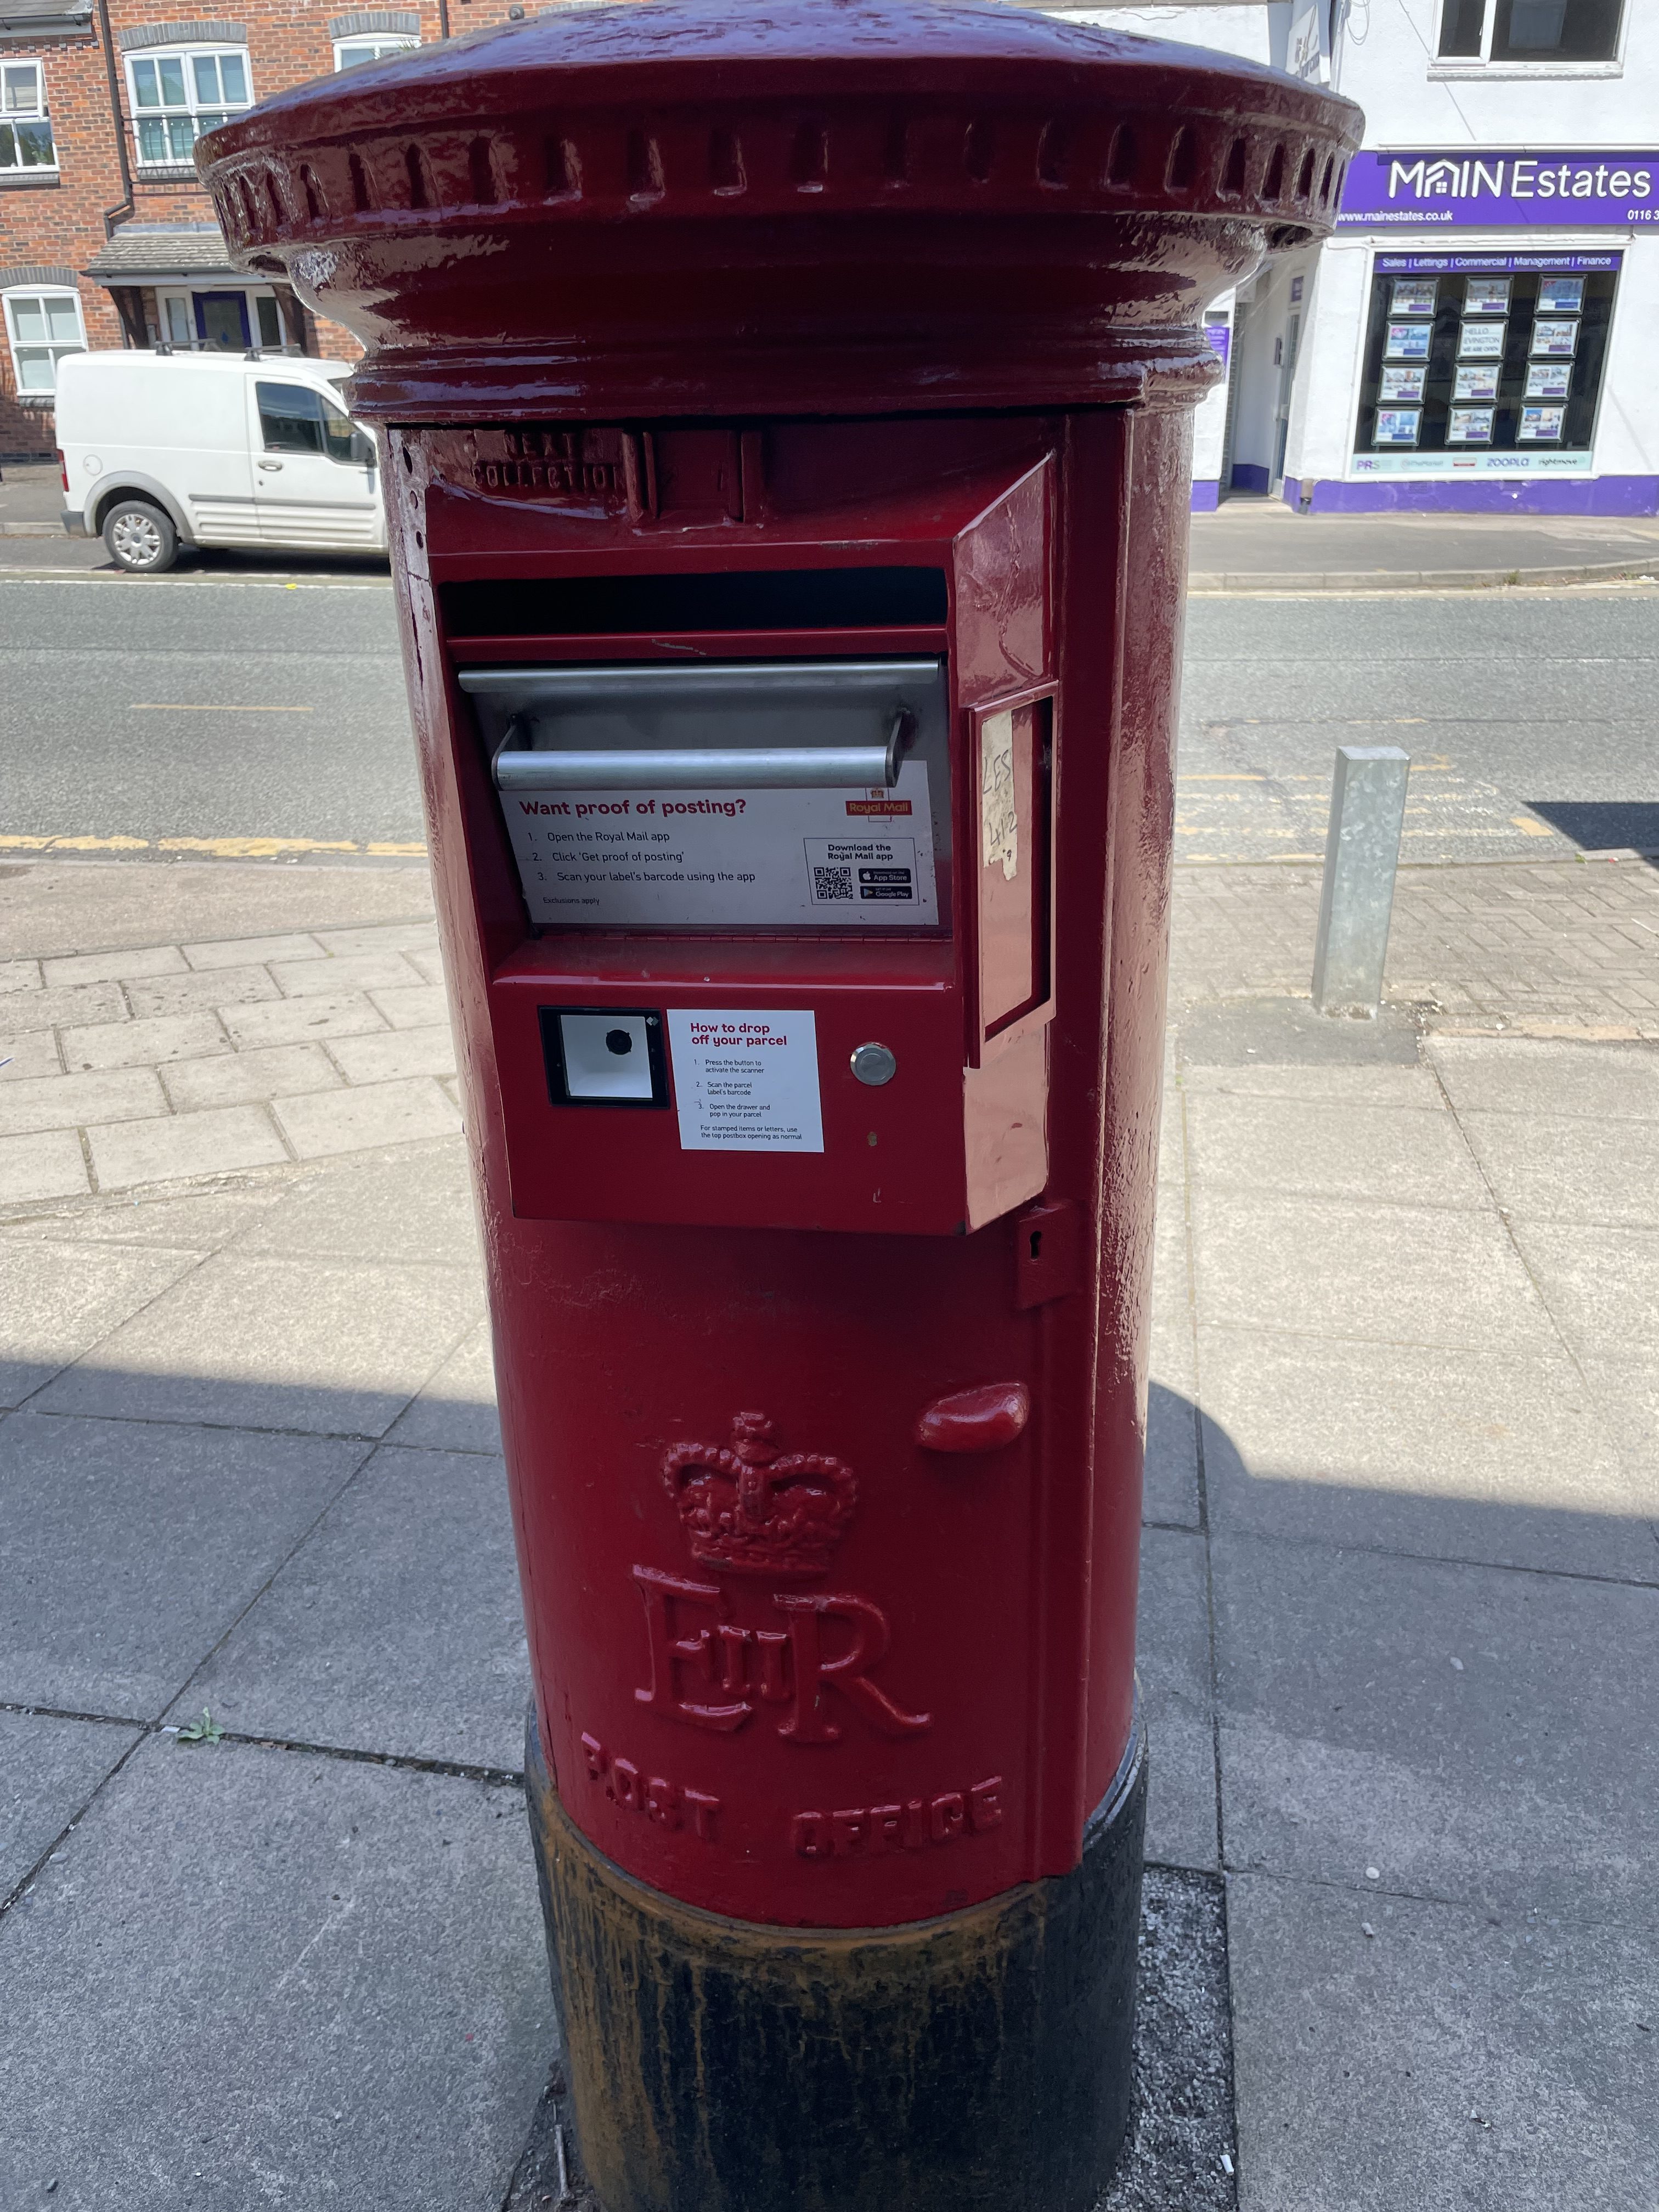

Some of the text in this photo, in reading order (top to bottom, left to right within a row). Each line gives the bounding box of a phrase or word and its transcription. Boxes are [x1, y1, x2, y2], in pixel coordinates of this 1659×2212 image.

[1388, 159, 1651, 199] MAIN Estates
[1627, 209, 1651, 221] 0116
[1382, 258, 1407, 267] Sales
[1413, 258, 1448, 269] Lettings
[1455, 257, 1506, 267] Commercial
[1514, 256, 1570, 268] Management
[1577, 256, 1612, 266] Finance
[519, 799, 746, 818] Want proof of posting?
[849, 802, 908, 814] Royal Mail
[528, 831, 670, 843] 1. Open the Royal Mail app
[532, 853, 542, 861] 2.
[552, 852, 577, 861] Click
[602, 852, 629, 863] proof
[632, 851, 641, 861] of
[827, 853, 853, 861] Royal
[537, 871, 755, 883] 3. Scan your label's barcode using the app
[582, 897, 600, 905] apply
[690, 1023, 770, 1035] How to drop
[691, 1034, 787, 1047] off your parcel
[580, 1730, 1003, 1858] POST OFFICE
